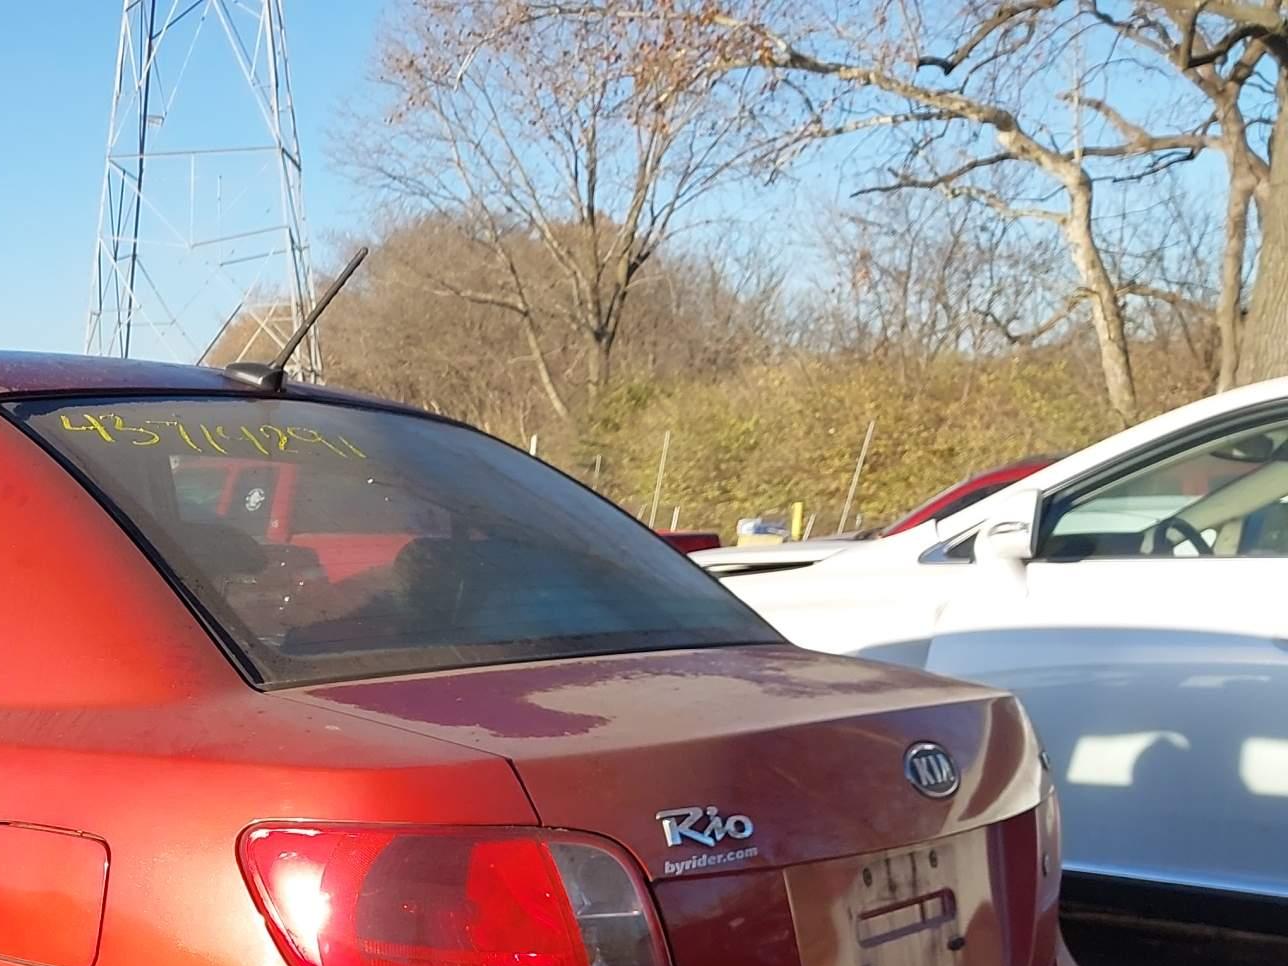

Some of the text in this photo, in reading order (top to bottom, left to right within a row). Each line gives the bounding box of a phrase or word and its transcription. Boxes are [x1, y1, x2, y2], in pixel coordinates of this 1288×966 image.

[60, 412, 367, 459] 43714291
[913, 752, 955, 786] KIA
[655, 805, 754, 847] Rio
[664, 846, 758, 875] byrider.com
